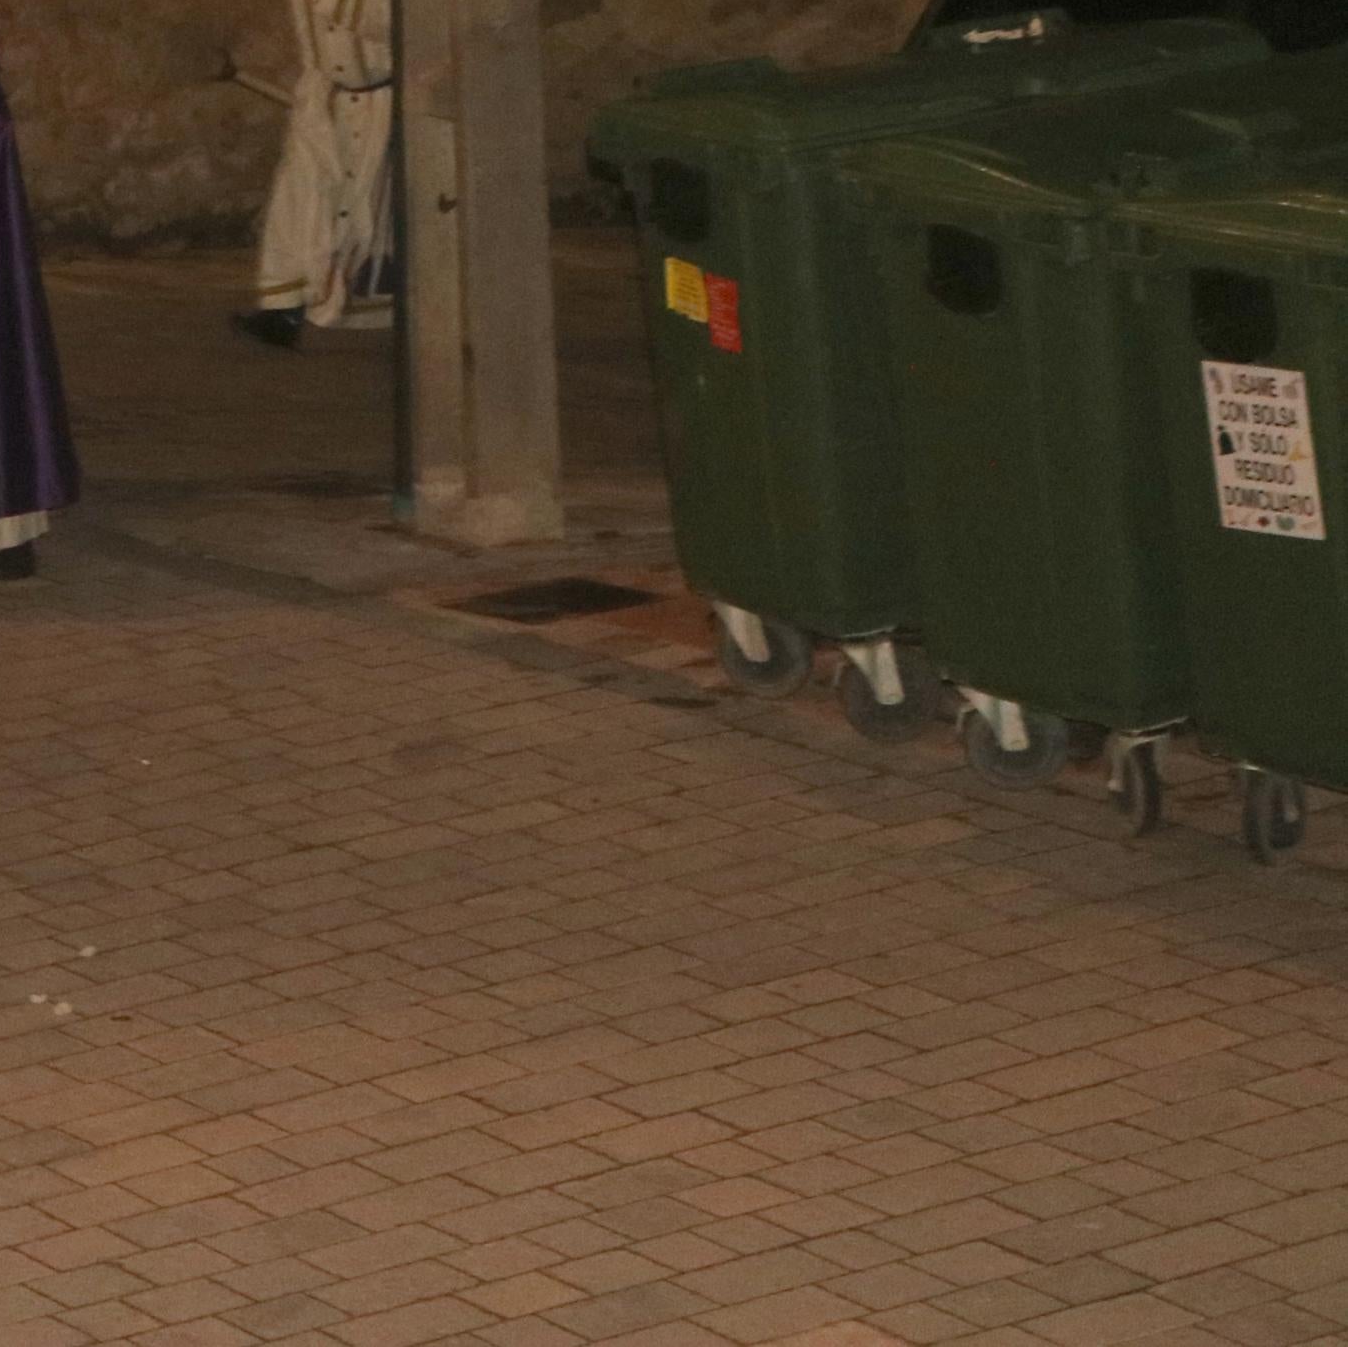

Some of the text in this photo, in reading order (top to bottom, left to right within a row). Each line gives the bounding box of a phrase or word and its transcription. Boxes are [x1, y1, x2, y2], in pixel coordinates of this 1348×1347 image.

[1218, 400, 1298, 428] CON BOLSA
[1235, 430, 1245, 450] Y
[1234, 458, 1296, 486] RESIDUO
[1223, 485, 1315, 517] DOMICILIARIO
